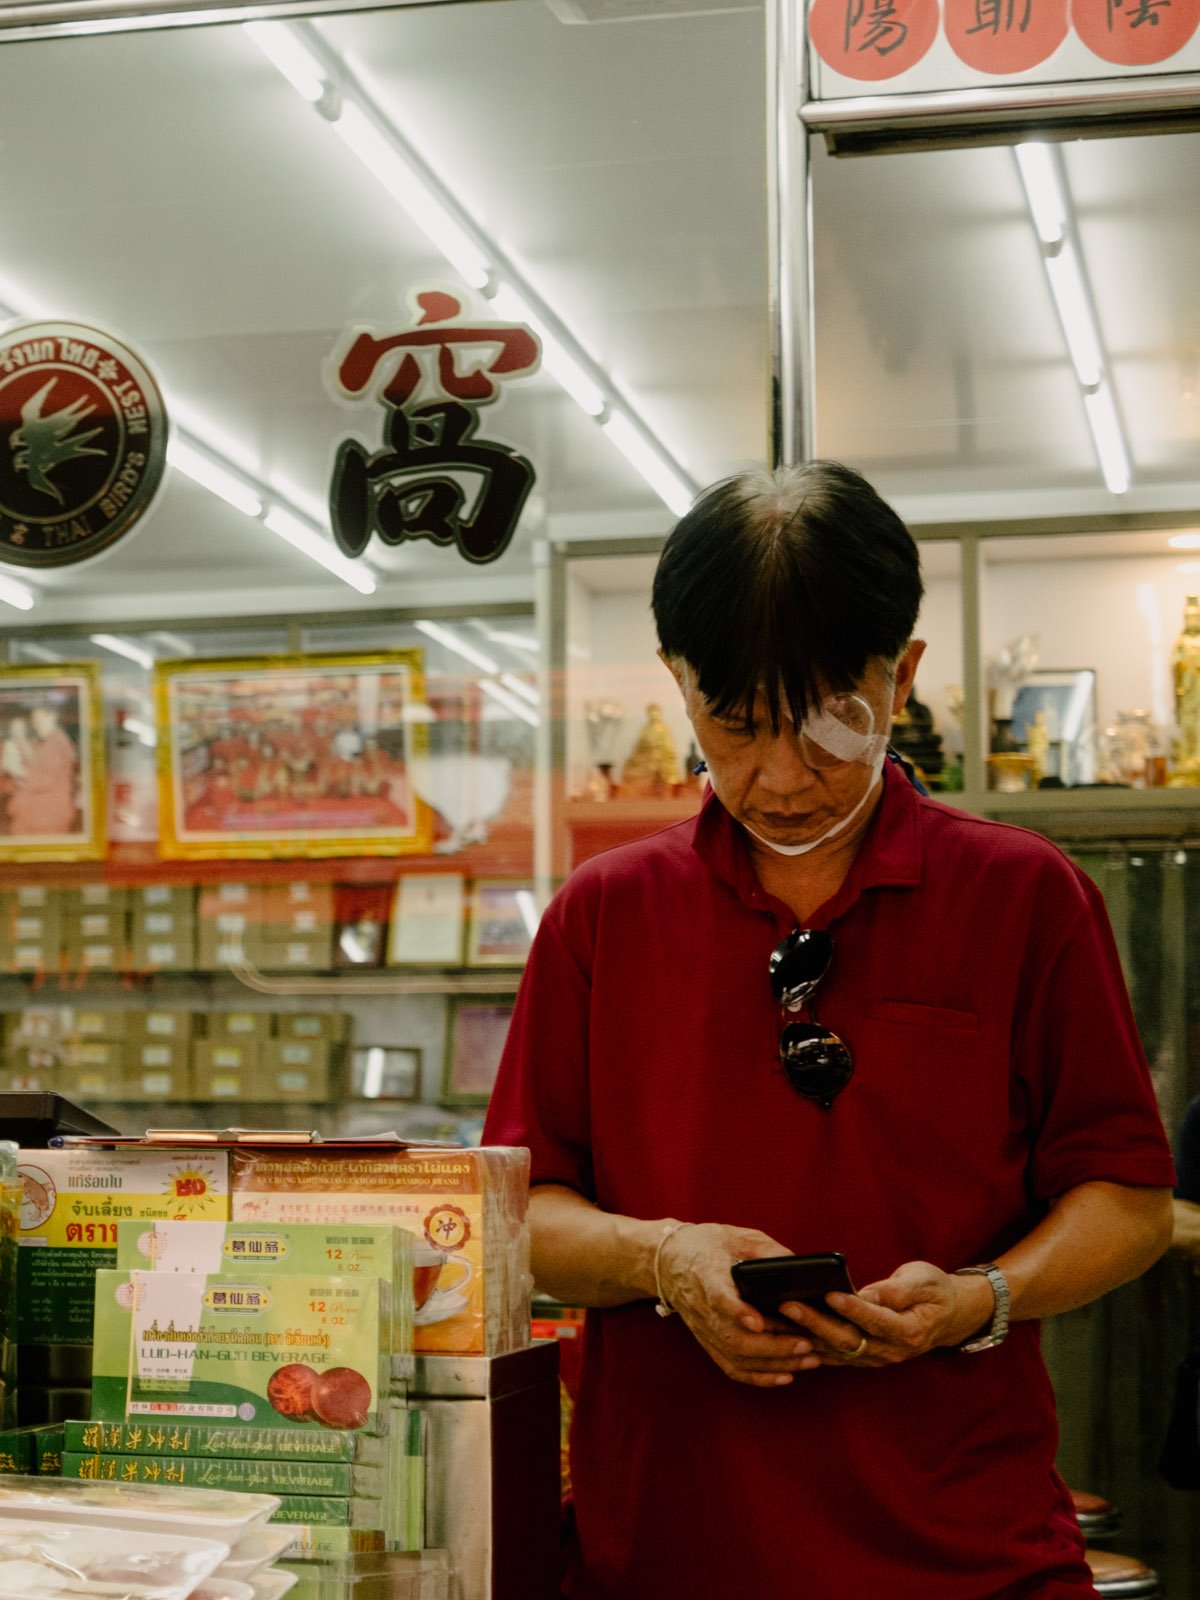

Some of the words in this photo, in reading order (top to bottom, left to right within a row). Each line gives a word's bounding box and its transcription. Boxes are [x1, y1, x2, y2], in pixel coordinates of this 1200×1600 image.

[41, 517, 94, 547] THAI
[112, 380, 149, 435] NEST
[432, 1178, 460, 1186] BRAND
[326, 1249, 342, 1260] 12
[309, 1301, 326, 1312] 12
[141, 1348, 248, 1361] LUO-HAN-GUO
[251, 1350, 330, 1364] BEVERAGE
[279, 1442, 337, 1453] BEVERAGE
[275, 1476, 334, 1487] BEVERAGE
[272, 1510, 330, 1521] BEVERAGE
